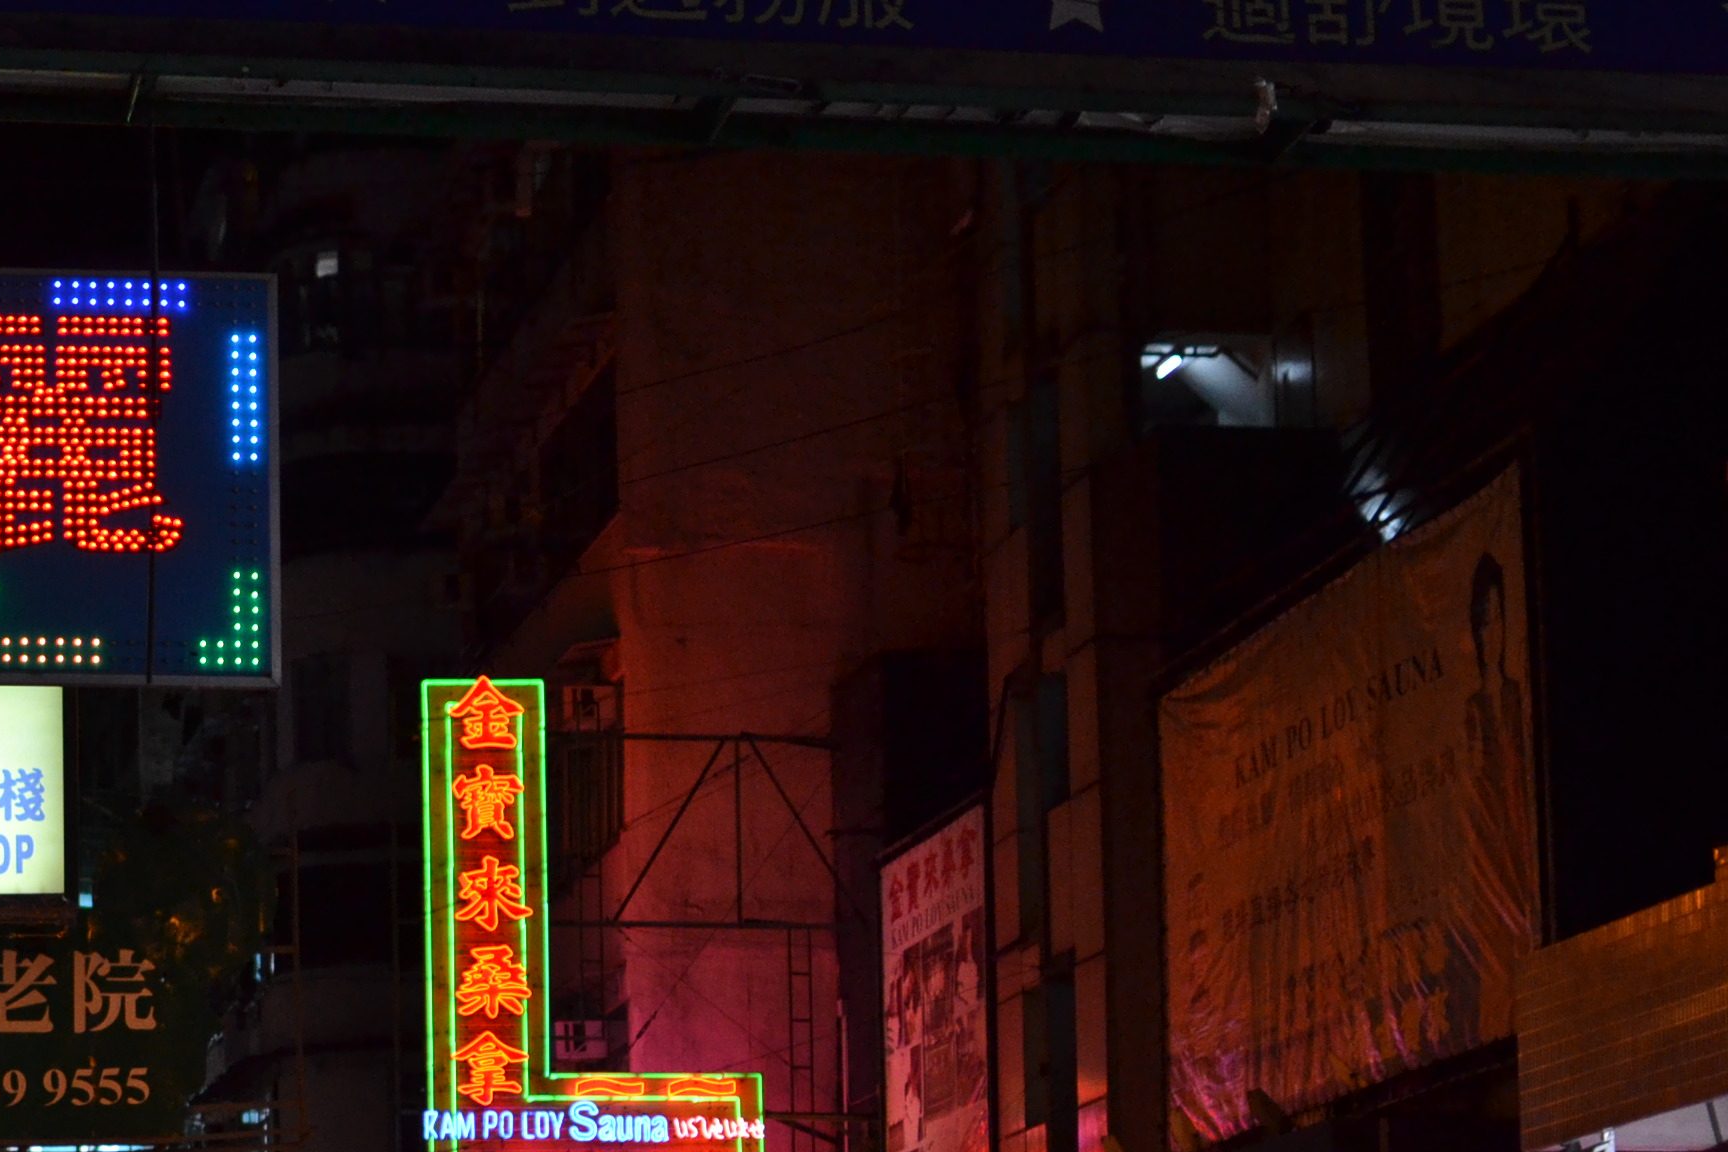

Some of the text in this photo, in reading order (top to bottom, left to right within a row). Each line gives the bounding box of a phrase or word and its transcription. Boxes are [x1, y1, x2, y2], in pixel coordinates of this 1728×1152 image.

[449, 674, 533, 1106] 金寶來桑拿
[42, 1065, 152, 1108] 9555
[423, 1101, 670, 1143] KAM PO LOY Sauna
